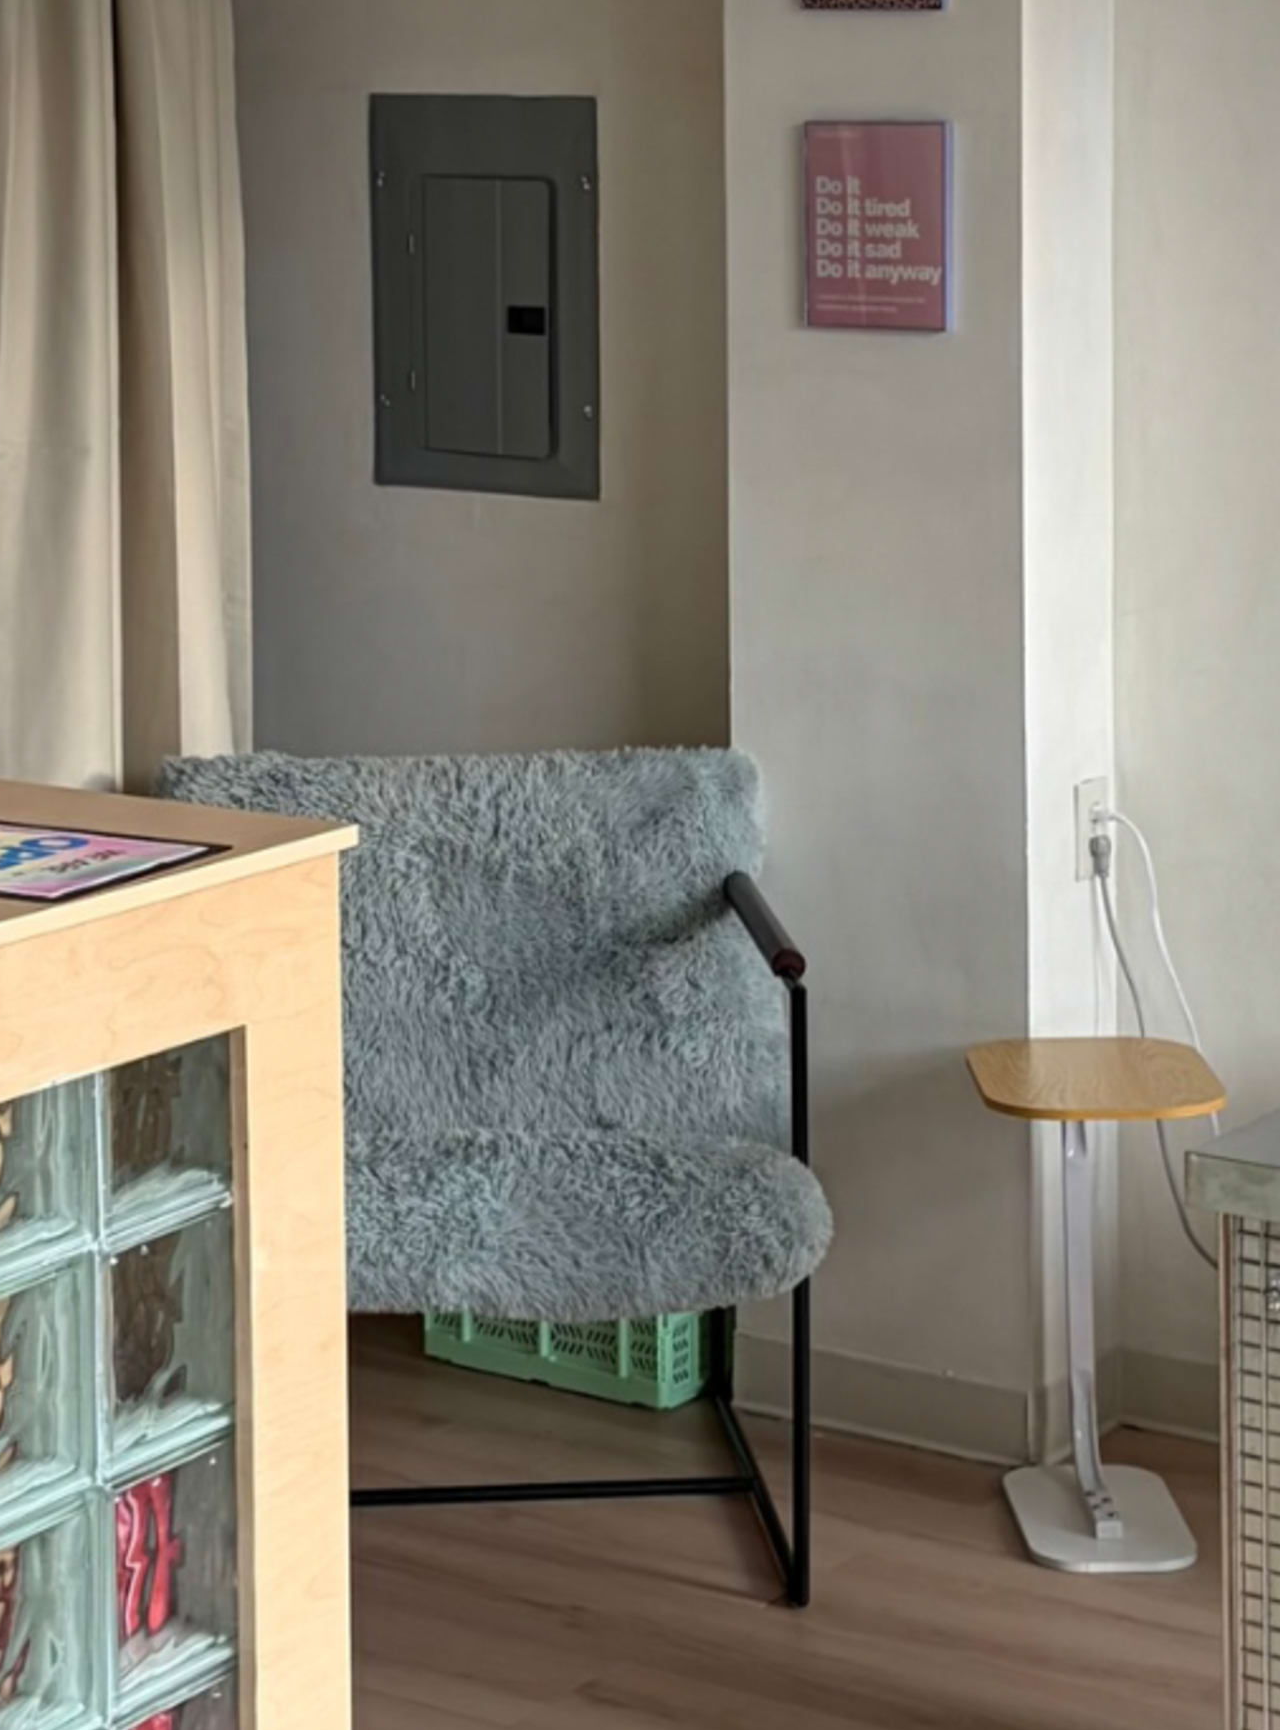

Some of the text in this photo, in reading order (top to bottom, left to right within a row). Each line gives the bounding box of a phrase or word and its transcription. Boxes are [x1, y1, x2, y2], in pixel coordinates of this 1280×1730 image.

[816, 175, 842, 194] Do
[816, 197, 842, 215] Do
[865, 198, 911, 217] tired
[816, 218, 842, 236] Do
[865, 219, 920, 238] weak
[816, 239, 842, 257] Do
[865, 241, 902, 259] sad
[816, 260, 842, 278] Do
[865, 264, 942, 285] anyway
